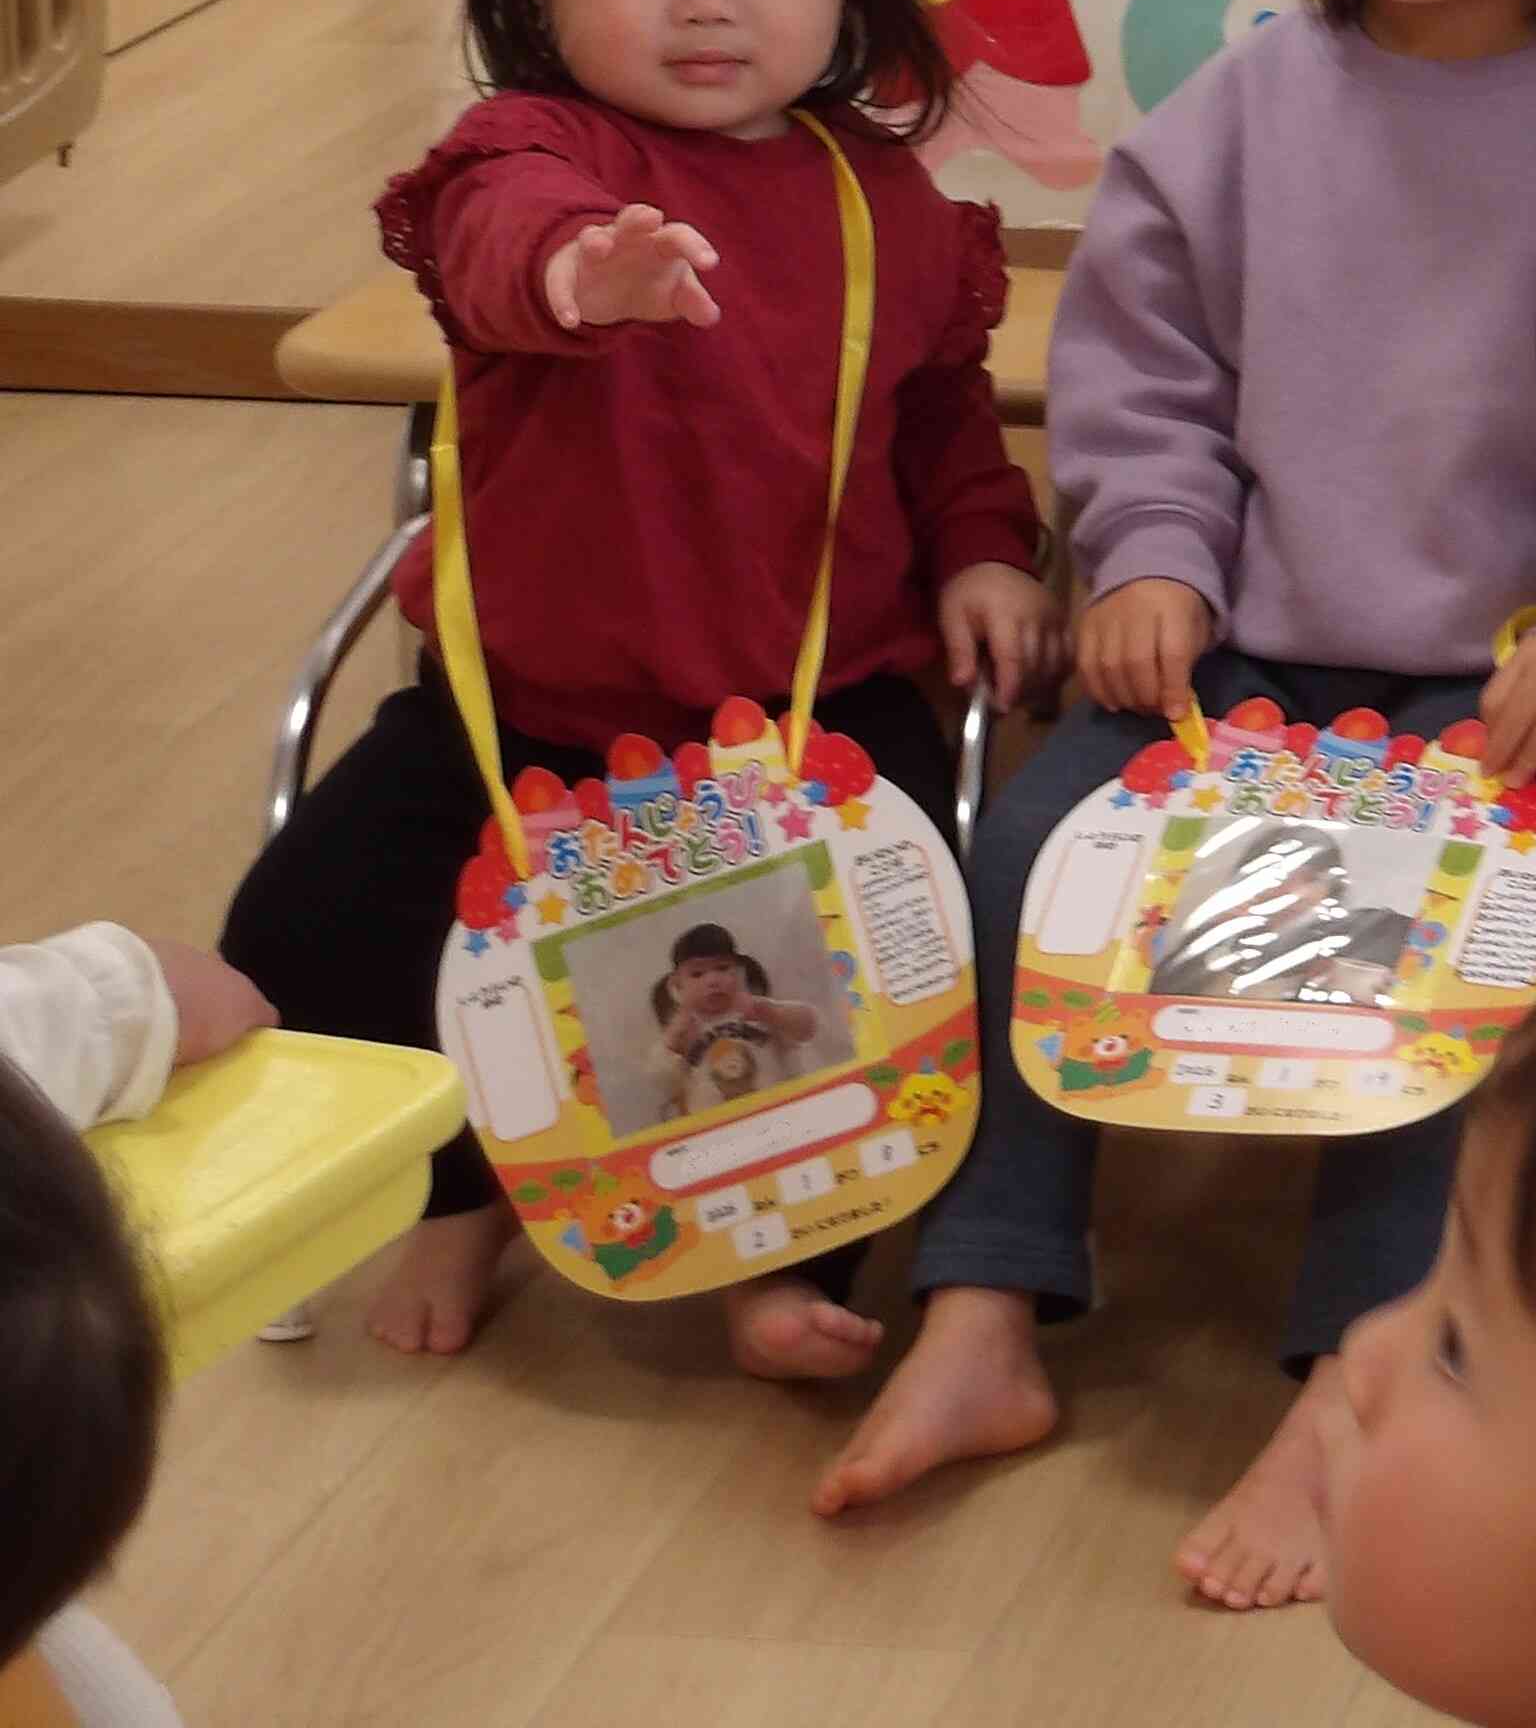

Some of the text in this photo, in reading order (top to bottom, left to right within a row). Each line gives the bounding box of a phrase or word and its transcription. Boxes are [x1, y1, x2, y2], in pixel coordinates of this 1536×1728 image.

[1226, 746, 1466, 800] おたんじょうび
[547, 760, 766, 878] おたんじょうび
